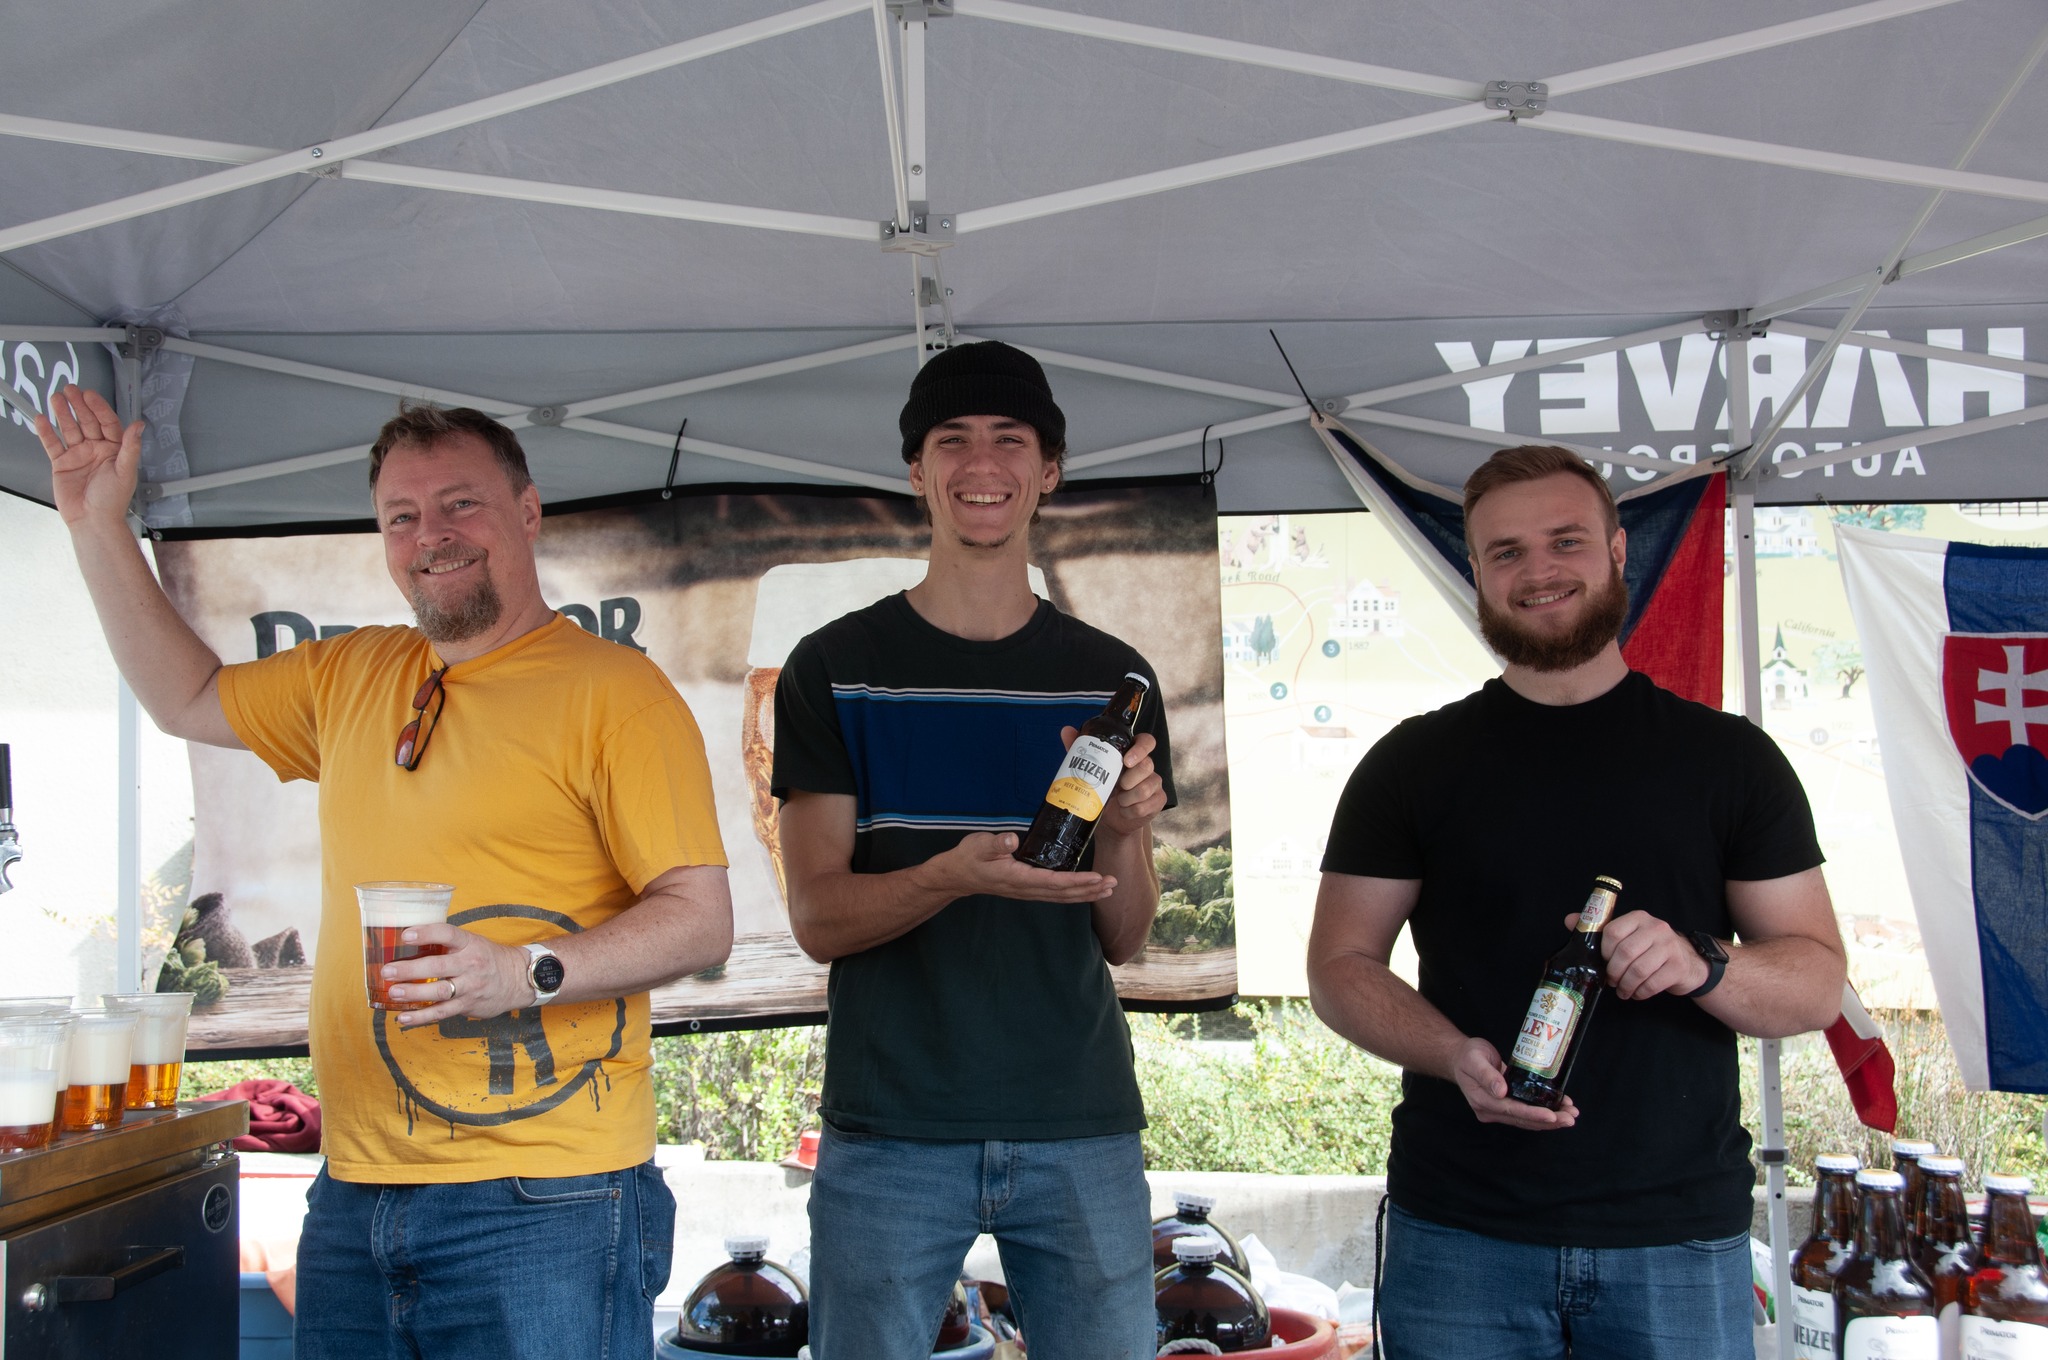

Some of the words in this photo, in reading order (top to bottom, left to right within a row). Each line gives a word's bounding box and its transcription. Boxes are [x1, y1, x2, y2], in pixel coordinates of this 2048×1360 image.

[1221, 571, 1241, 584] eek
[1248, 571, 1281, 583] Road
[1783, 618, 1837, 639] California
[1068, 755, 1110, 785] WEIZEN
[1074, 786, 1091, 797] WEIZEN
[1583, 905, 1603, 916] LEV
[1582, 914, 1594, 922] LION
[1521, 1016, 1563, 1042] LEV
[1980, 1325, 2019, 1340] PRIMATOR
